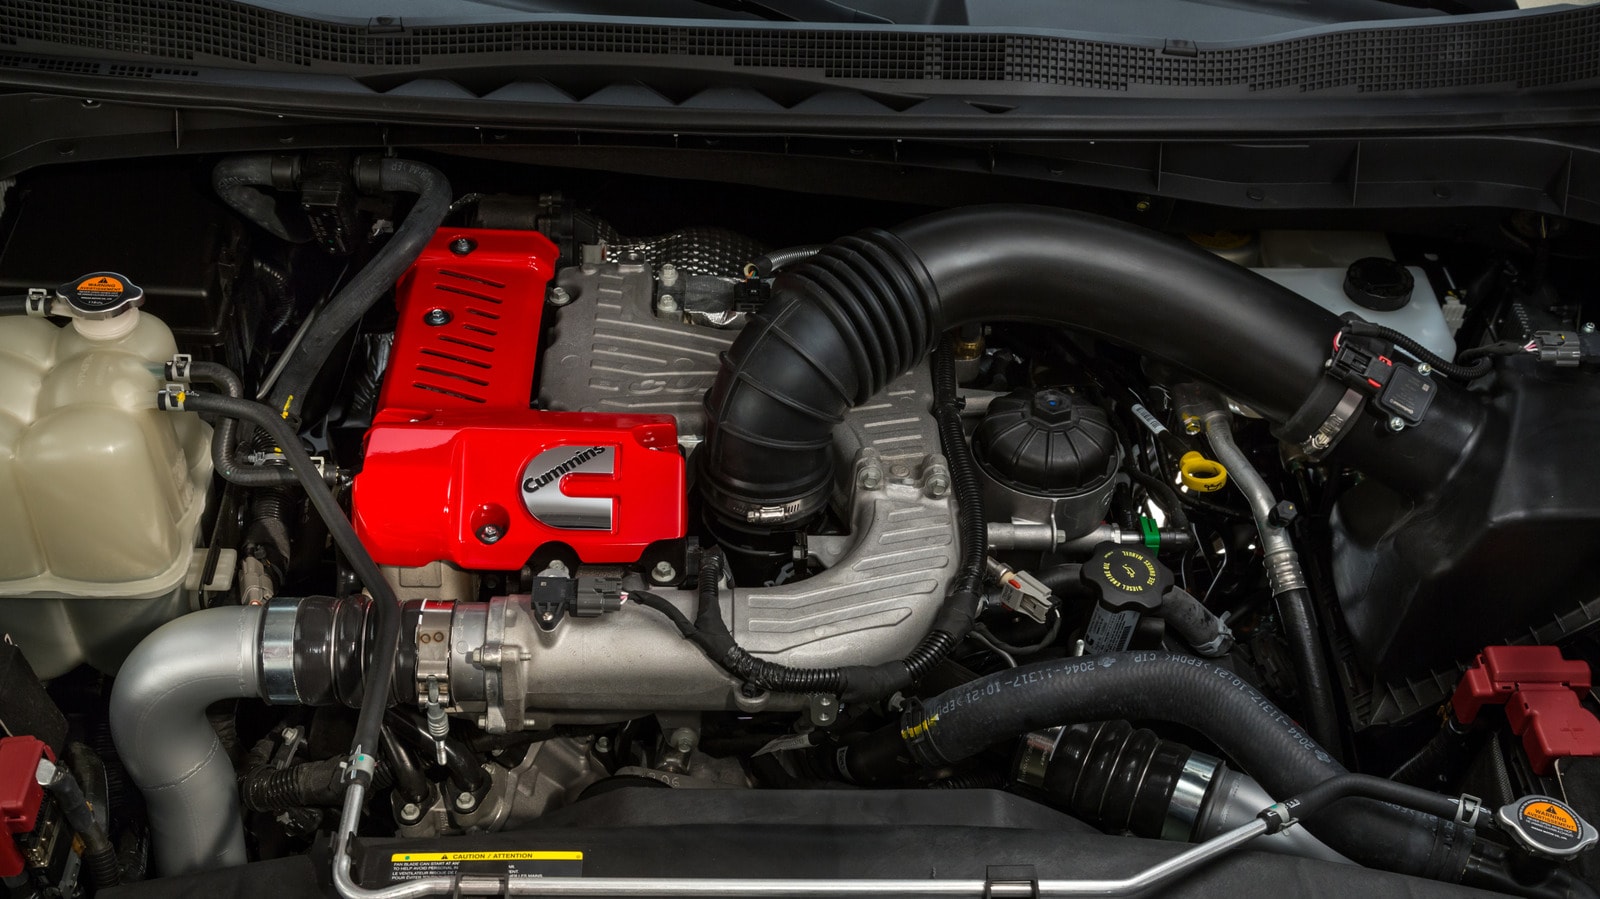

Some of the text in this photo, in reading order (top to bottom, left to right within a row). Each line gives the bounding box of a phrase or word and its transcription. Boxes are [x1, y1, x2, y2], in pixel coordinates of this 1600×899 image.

[523, 446, 606, 493] Cummins
[1134, 653, 1156, 663] CIP
[1527, 812, 1574, 830] AVERTISSEMENT
[1535, 808, 1566, 822] WARNING
